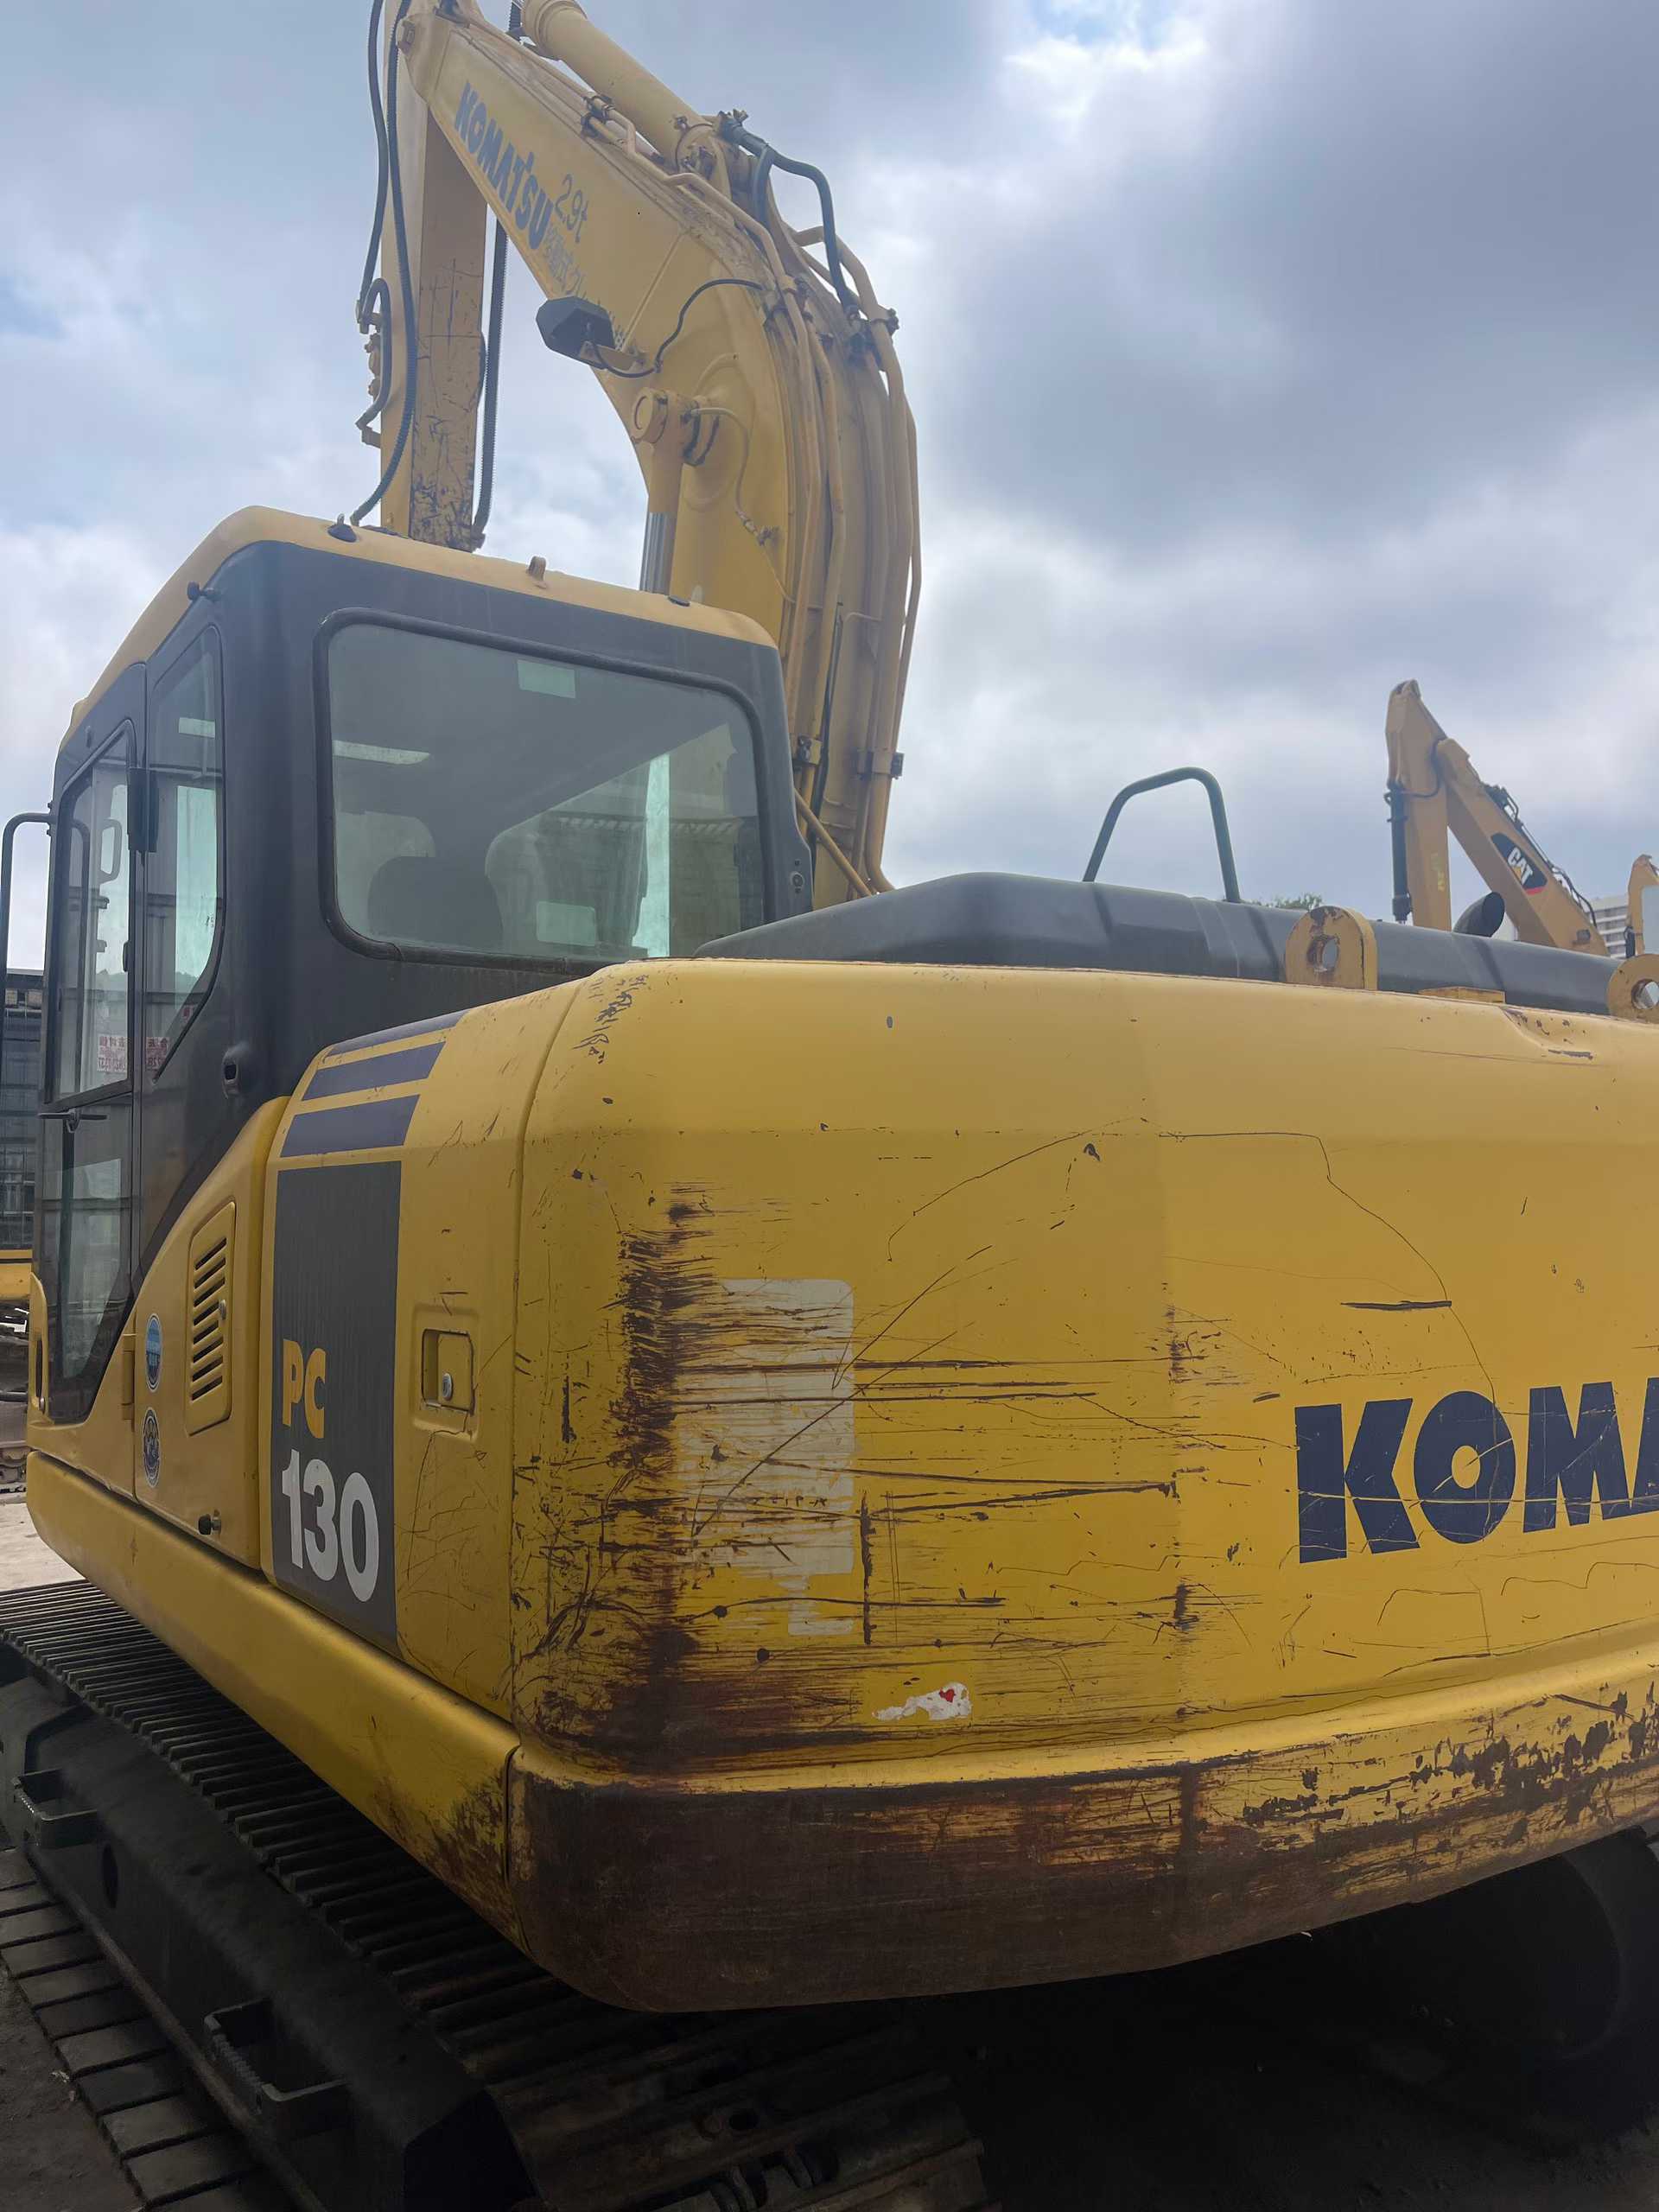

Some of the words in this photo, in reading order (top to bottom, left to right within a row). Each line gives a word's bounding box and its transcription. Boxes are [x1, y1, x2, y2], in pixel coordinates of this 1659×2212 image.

[455, 83, 554, 249] KOMATSU
[1508, 847, 1533, 884] CAT
[283, 1338, 326, 1439] PC
[282, 1449, 379, 1602] 130
